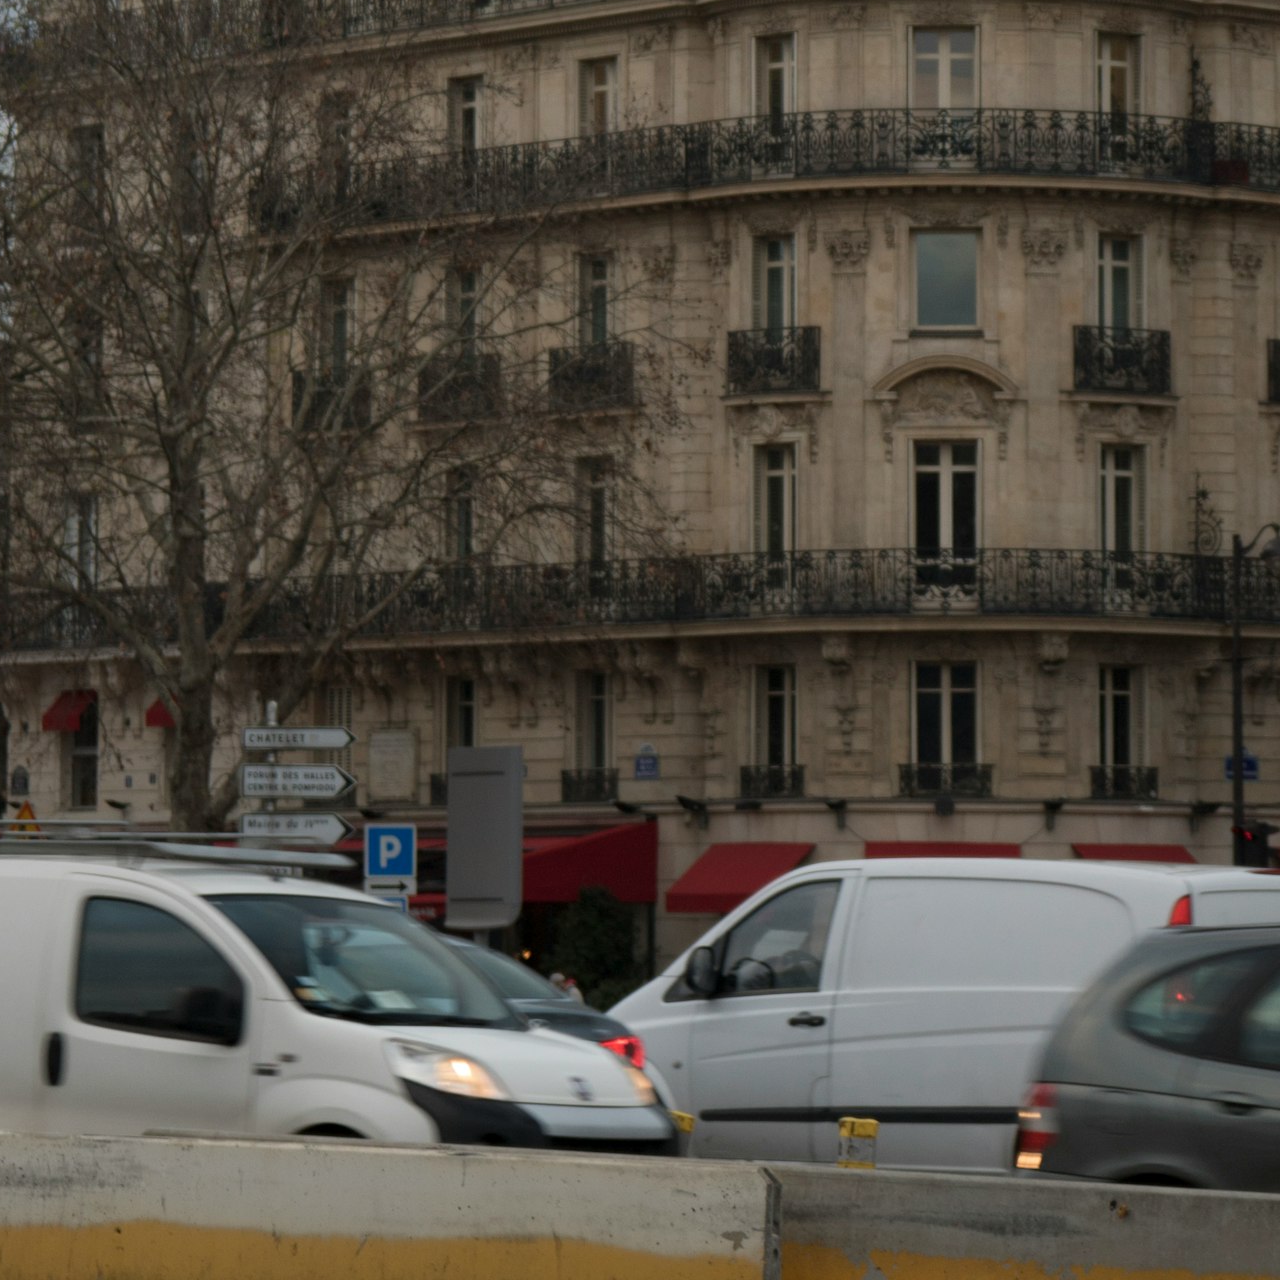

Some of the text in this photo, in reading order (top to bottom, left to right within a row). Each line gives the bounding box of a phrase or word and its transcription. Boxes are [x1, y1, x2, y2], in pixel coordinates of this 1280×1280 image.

[248, 732, 306, 743] CHATELET
[247, 770, 336, 780] FORUM DES HALLES
[292, 783, 336, 793] POMPIDOU
[379, 834, 402, 869] P
